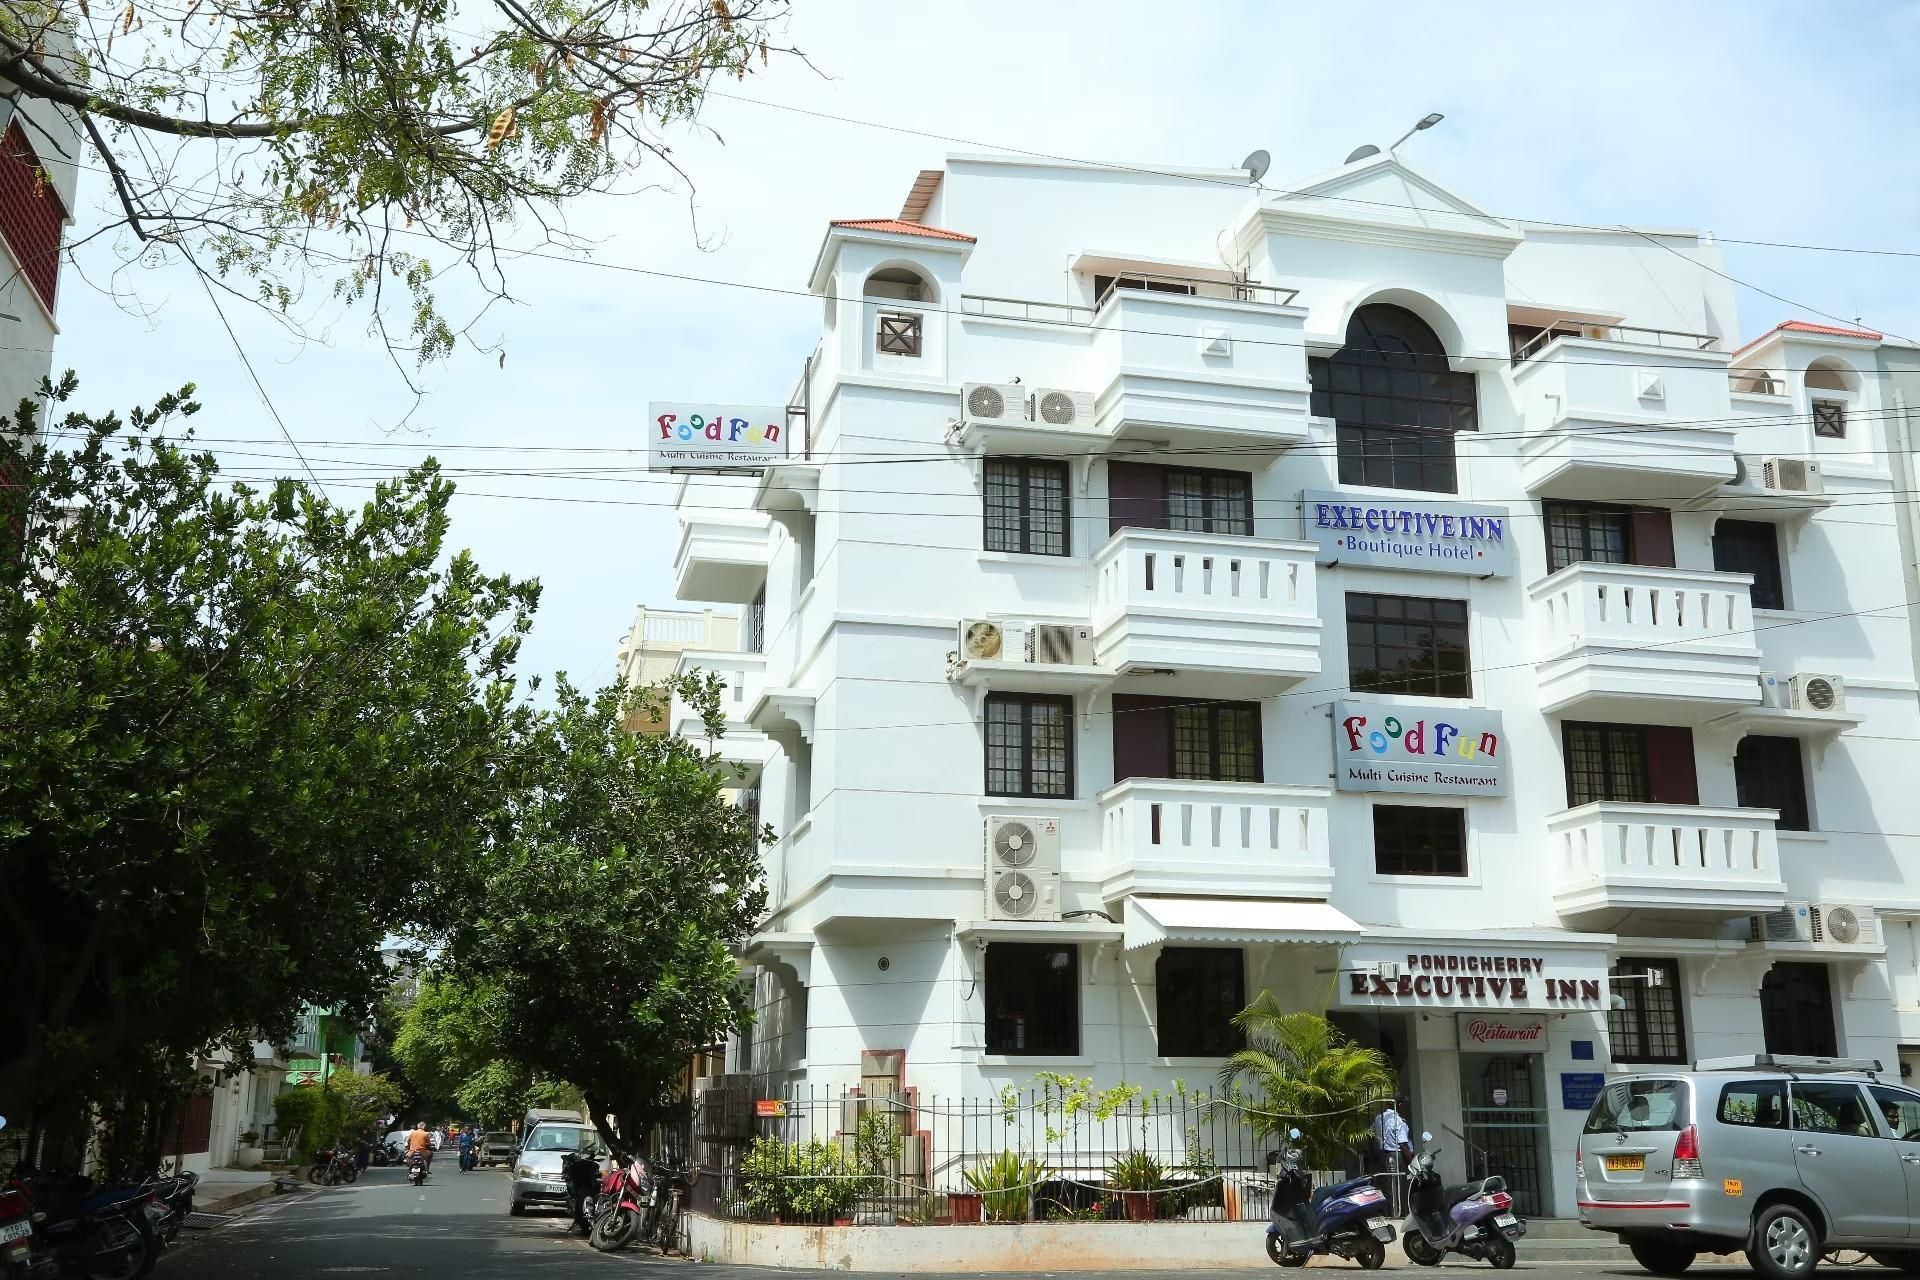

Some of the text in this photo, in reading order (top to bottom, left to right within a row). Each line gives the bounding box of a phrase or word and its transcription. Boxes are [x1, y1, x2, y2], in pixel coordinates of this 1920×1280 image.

[657, 413, 723, 441] Food
[1346, 535, 1474, 560] Boutique Hotel
[1343, 716, 1497, 760] Food Fun
[1349, 767, 1497, 787] Multi Cuisine Restaurant
[1407, 954, 1544, 973] PONDICHERRY
[1350, 972, 1601, 1001] EXECUTIVE INN
[1468, 1020, 1543, 1043] Restaurant
